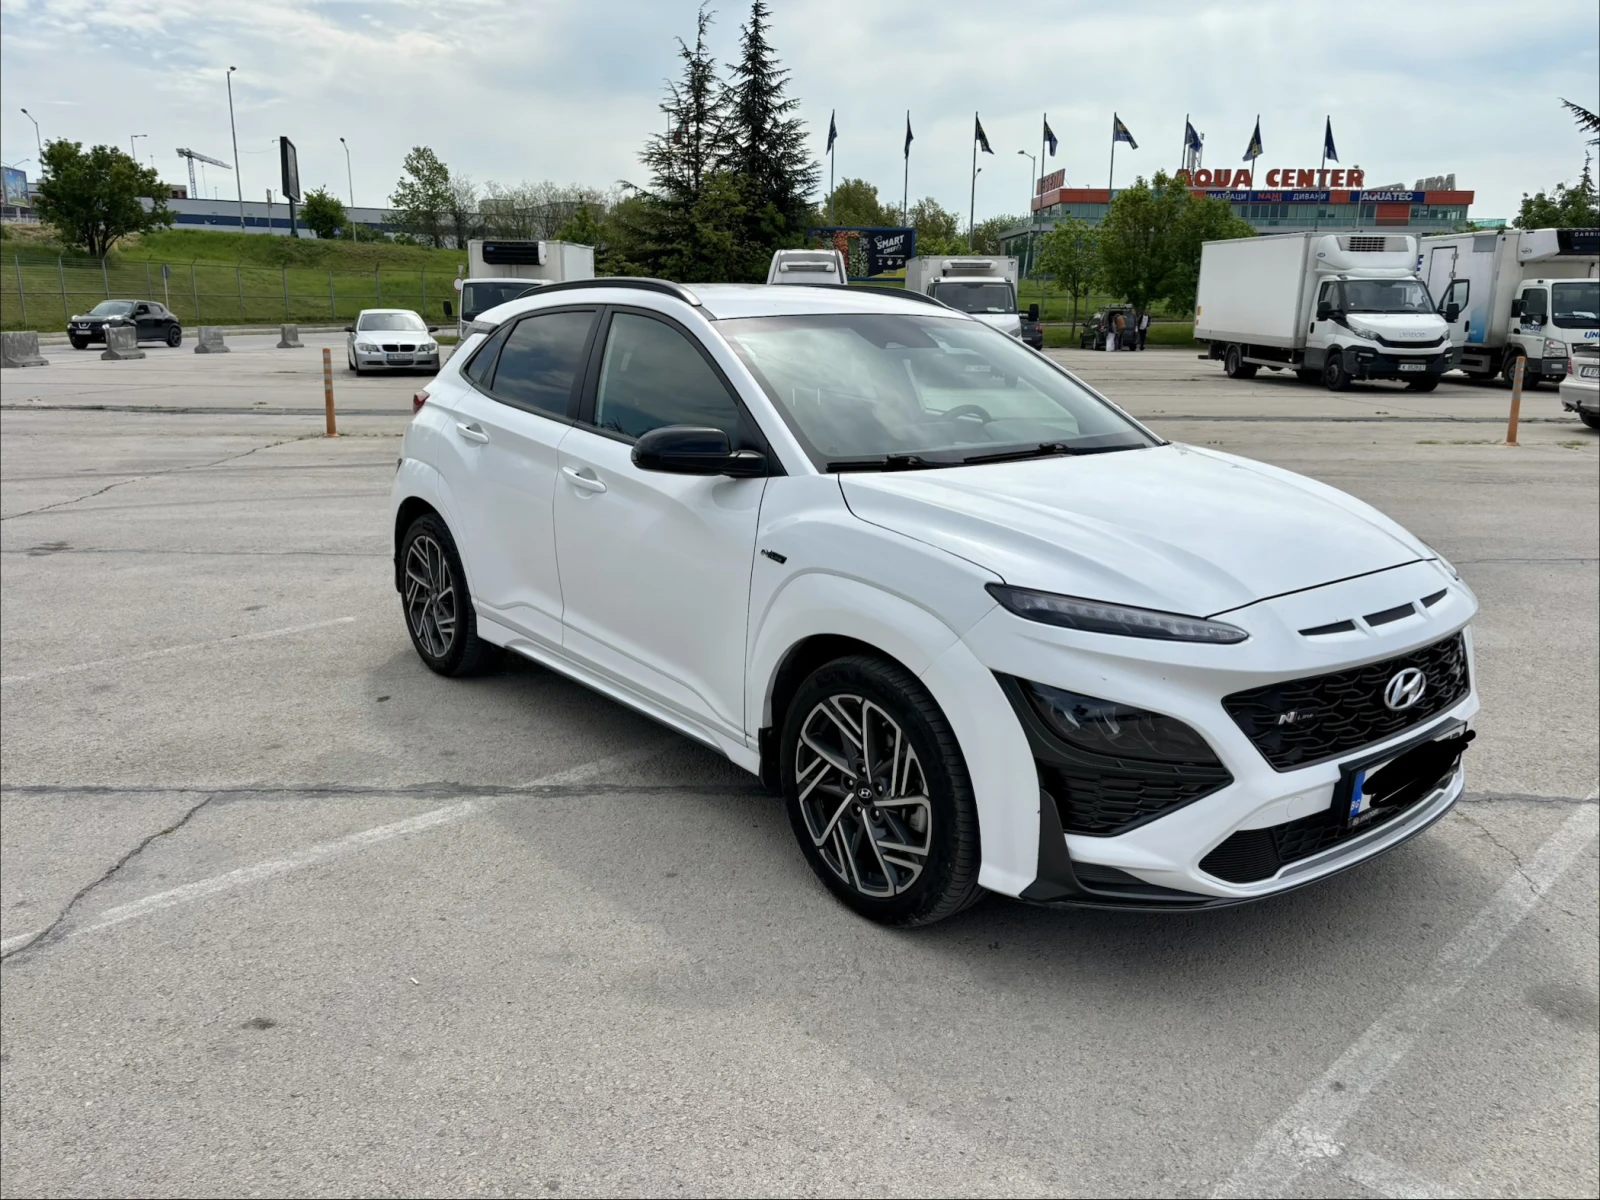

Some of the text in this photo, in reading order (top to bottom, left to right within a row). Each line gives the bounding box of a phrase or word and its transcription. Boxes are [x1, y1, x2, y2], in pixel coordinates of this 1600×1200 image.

[1174, 168, 1365, 188] AQUA CENTER
[1292, 192, 1327, 201] ДИВАНИ
[1361, 191, 1413, 202] AQUATEC
[877, 234, 905, 250] SMART
[1350, 799, 1361, 812] BG
